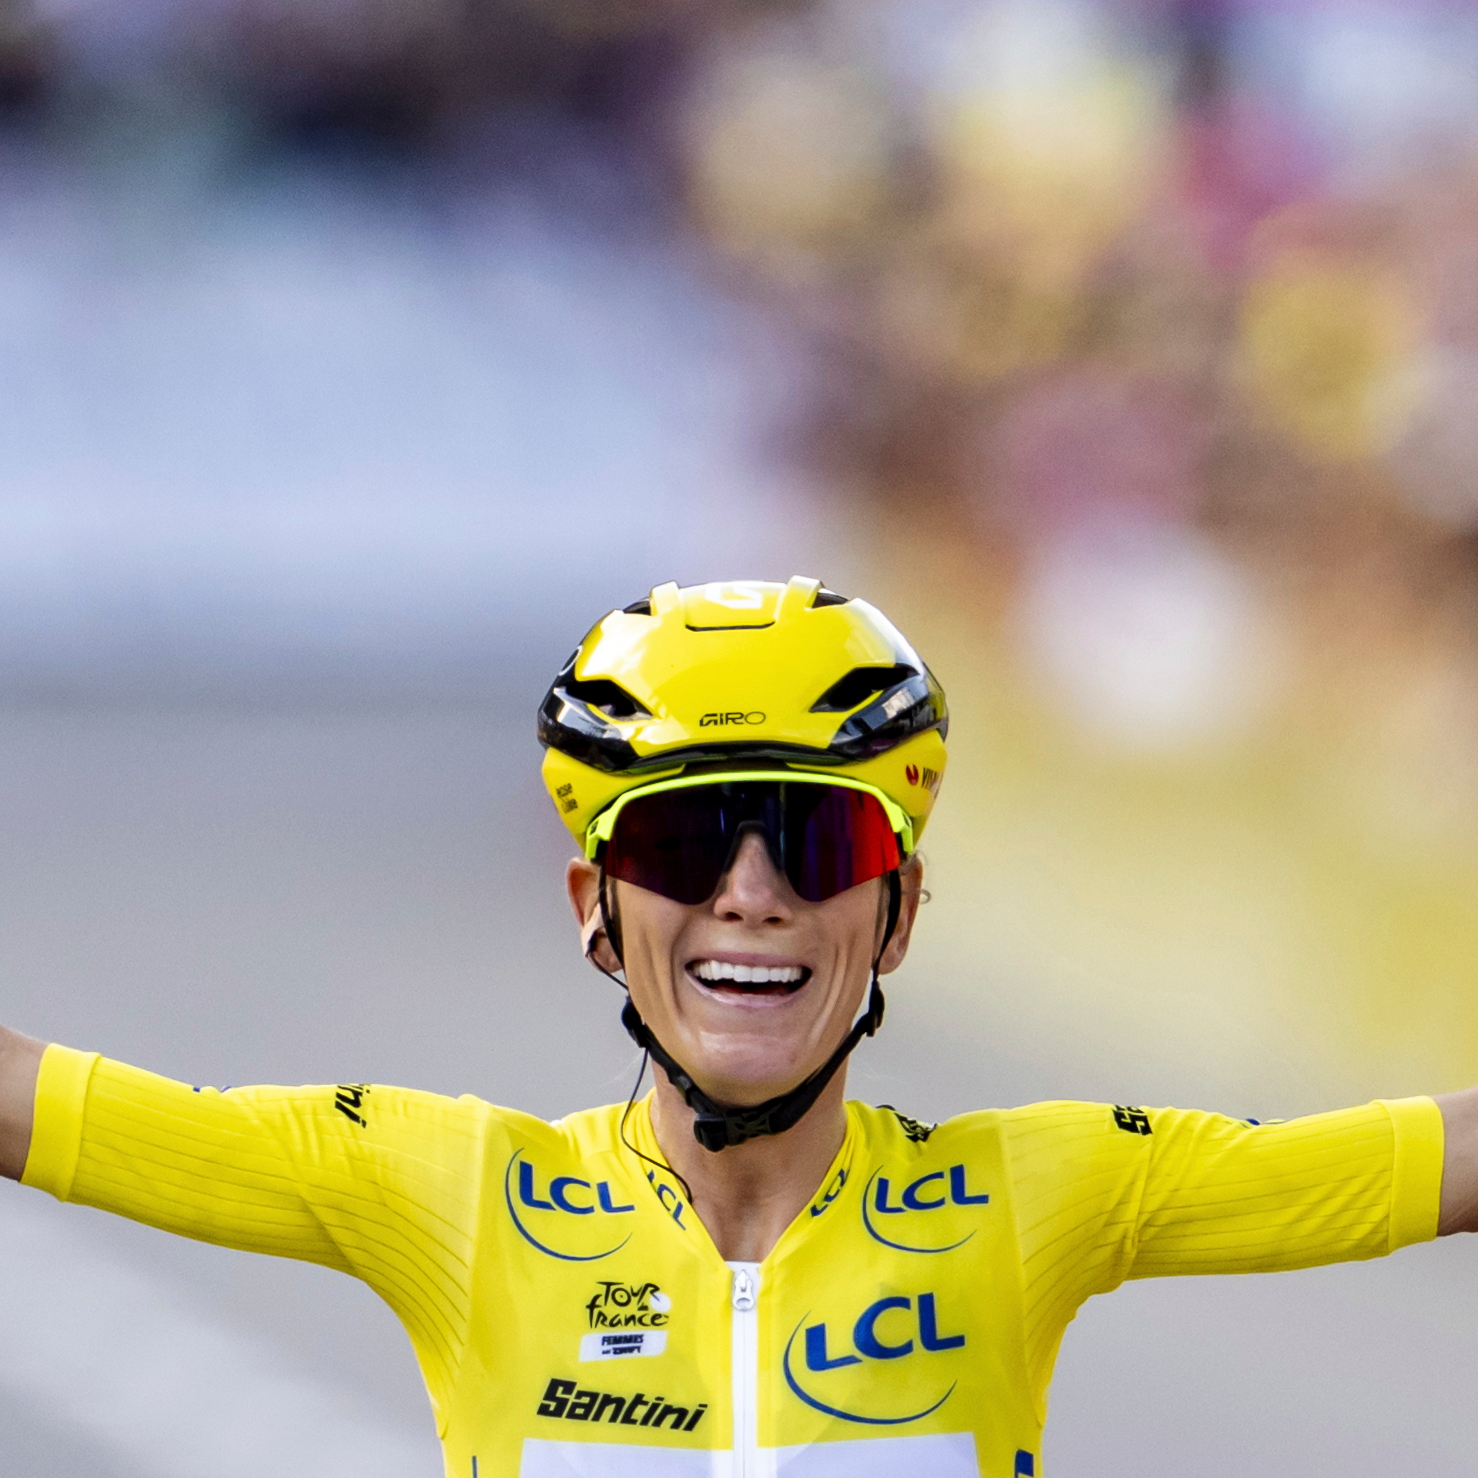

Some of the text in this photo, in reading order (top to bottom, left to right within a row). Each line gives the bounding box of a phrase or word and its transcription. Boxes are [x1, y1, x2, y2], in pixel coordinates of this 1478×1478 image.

[699, 711, 766, 727] GIRO
[519, 1160, 634, 1214] LCL
[875, 1164, 989, 1214] LCL
[805, 1292, 965, 1372] LCL
[537, 1378, 708, 1431] Santini
